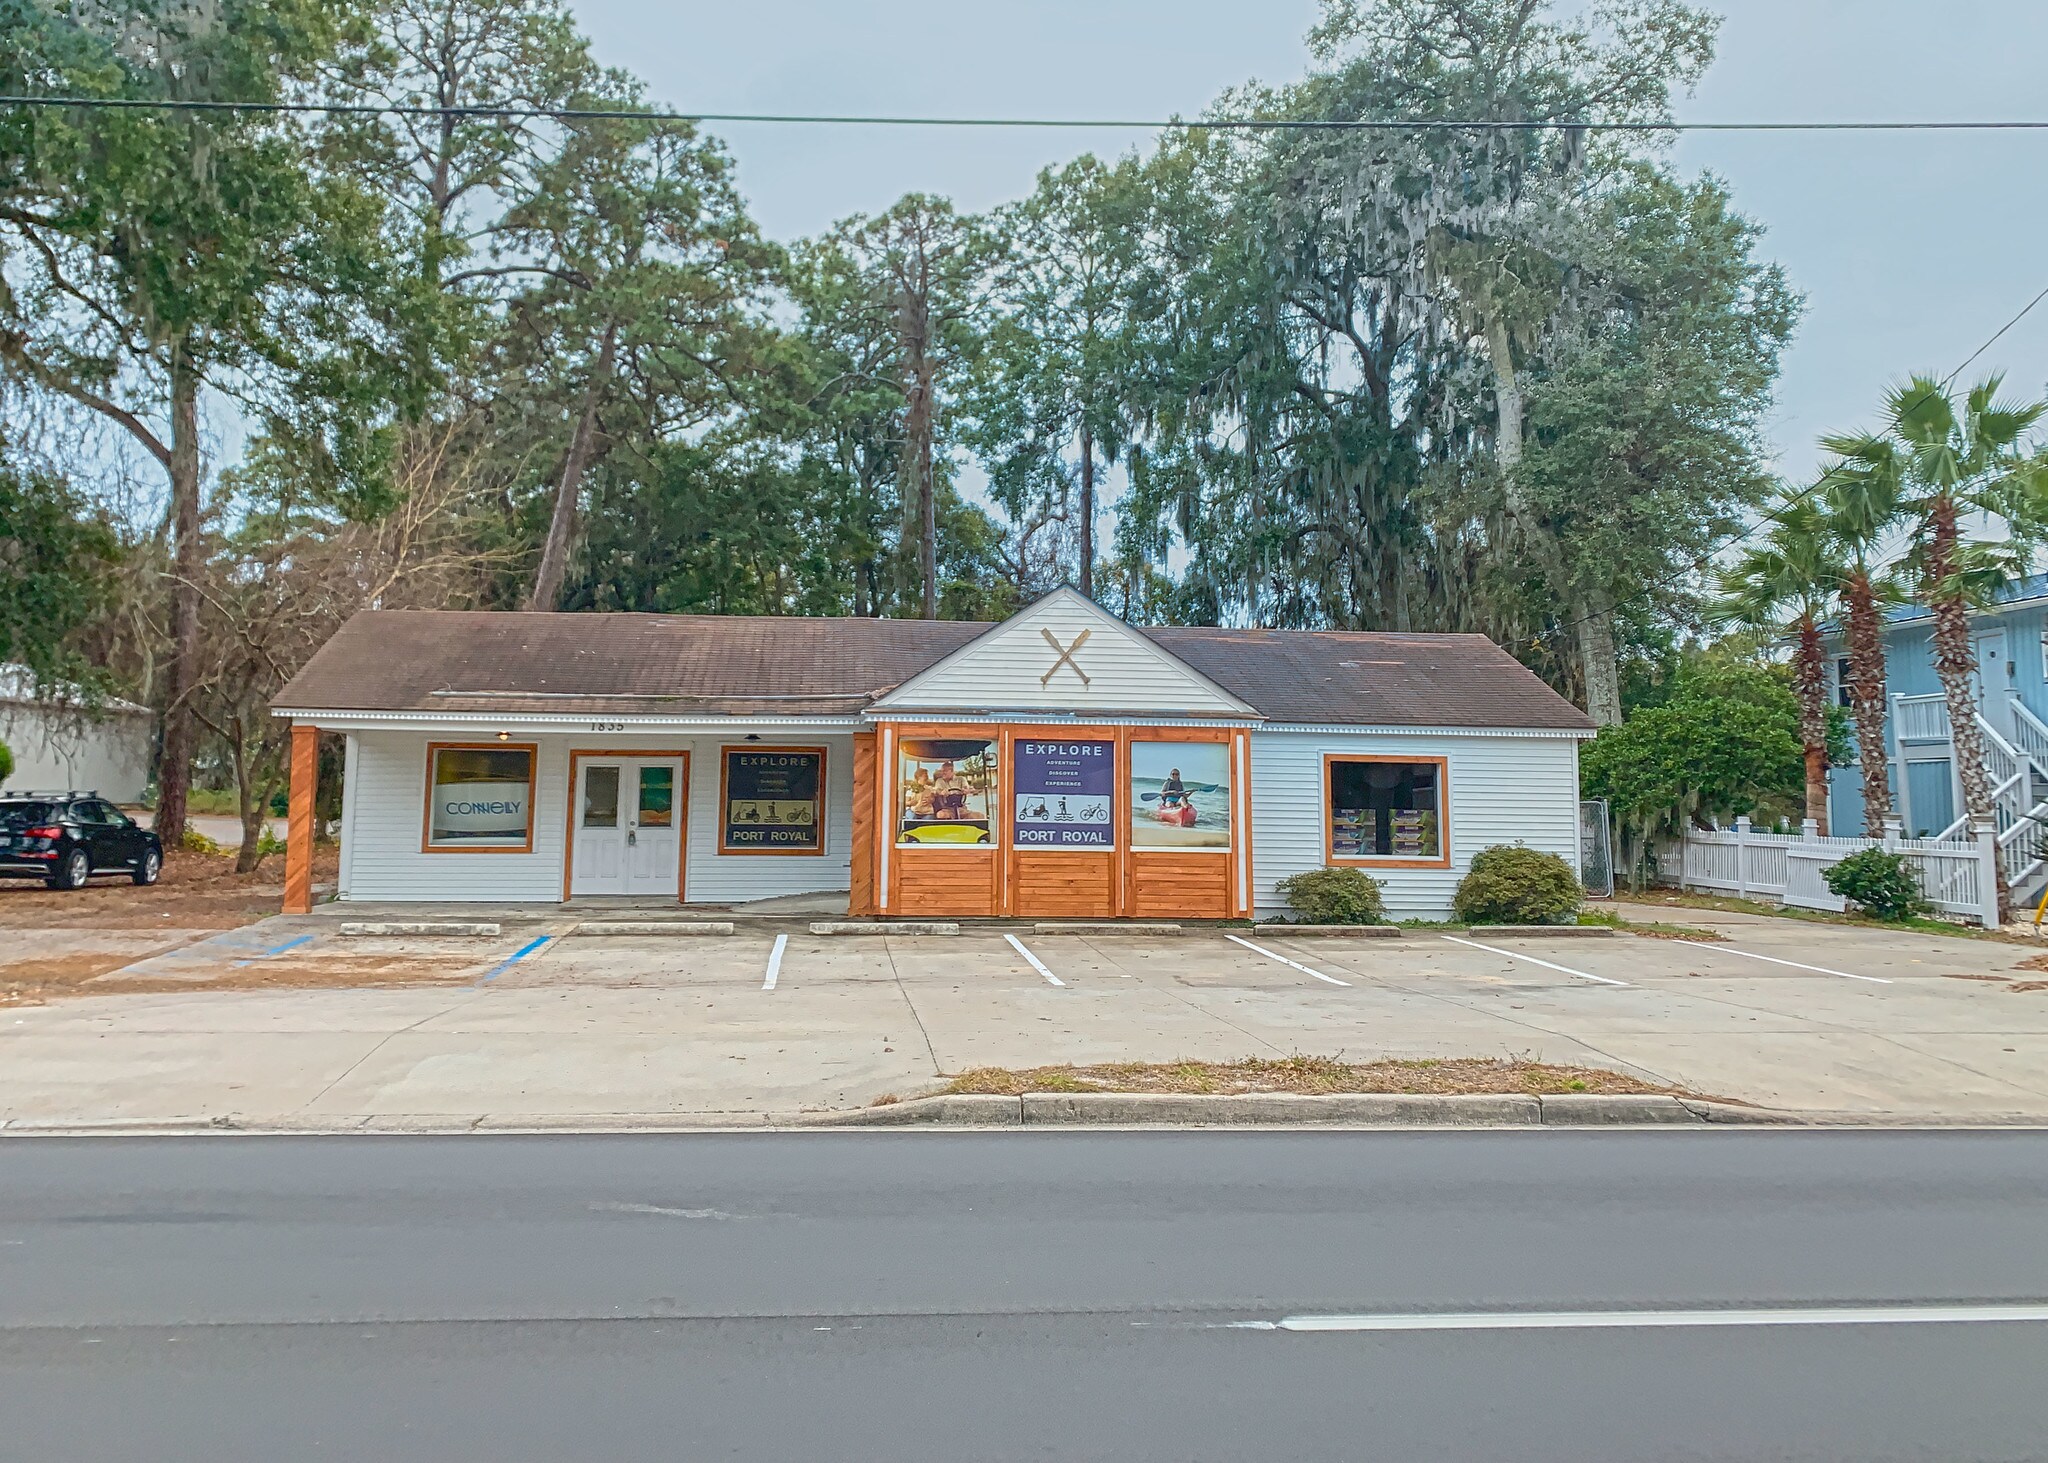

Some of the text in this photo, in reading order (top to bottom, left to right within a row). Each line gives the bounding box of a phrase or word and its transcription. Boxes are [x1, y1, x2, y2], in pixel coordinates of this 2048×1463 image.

[1025, 744, 1103, 756] EXPLORE
[740, 757, 809, 766] EXPLORE
[733, 831, 810, 841] PORT ROYAL
[1019, 830, 1107, 843] PORT ROYAL
